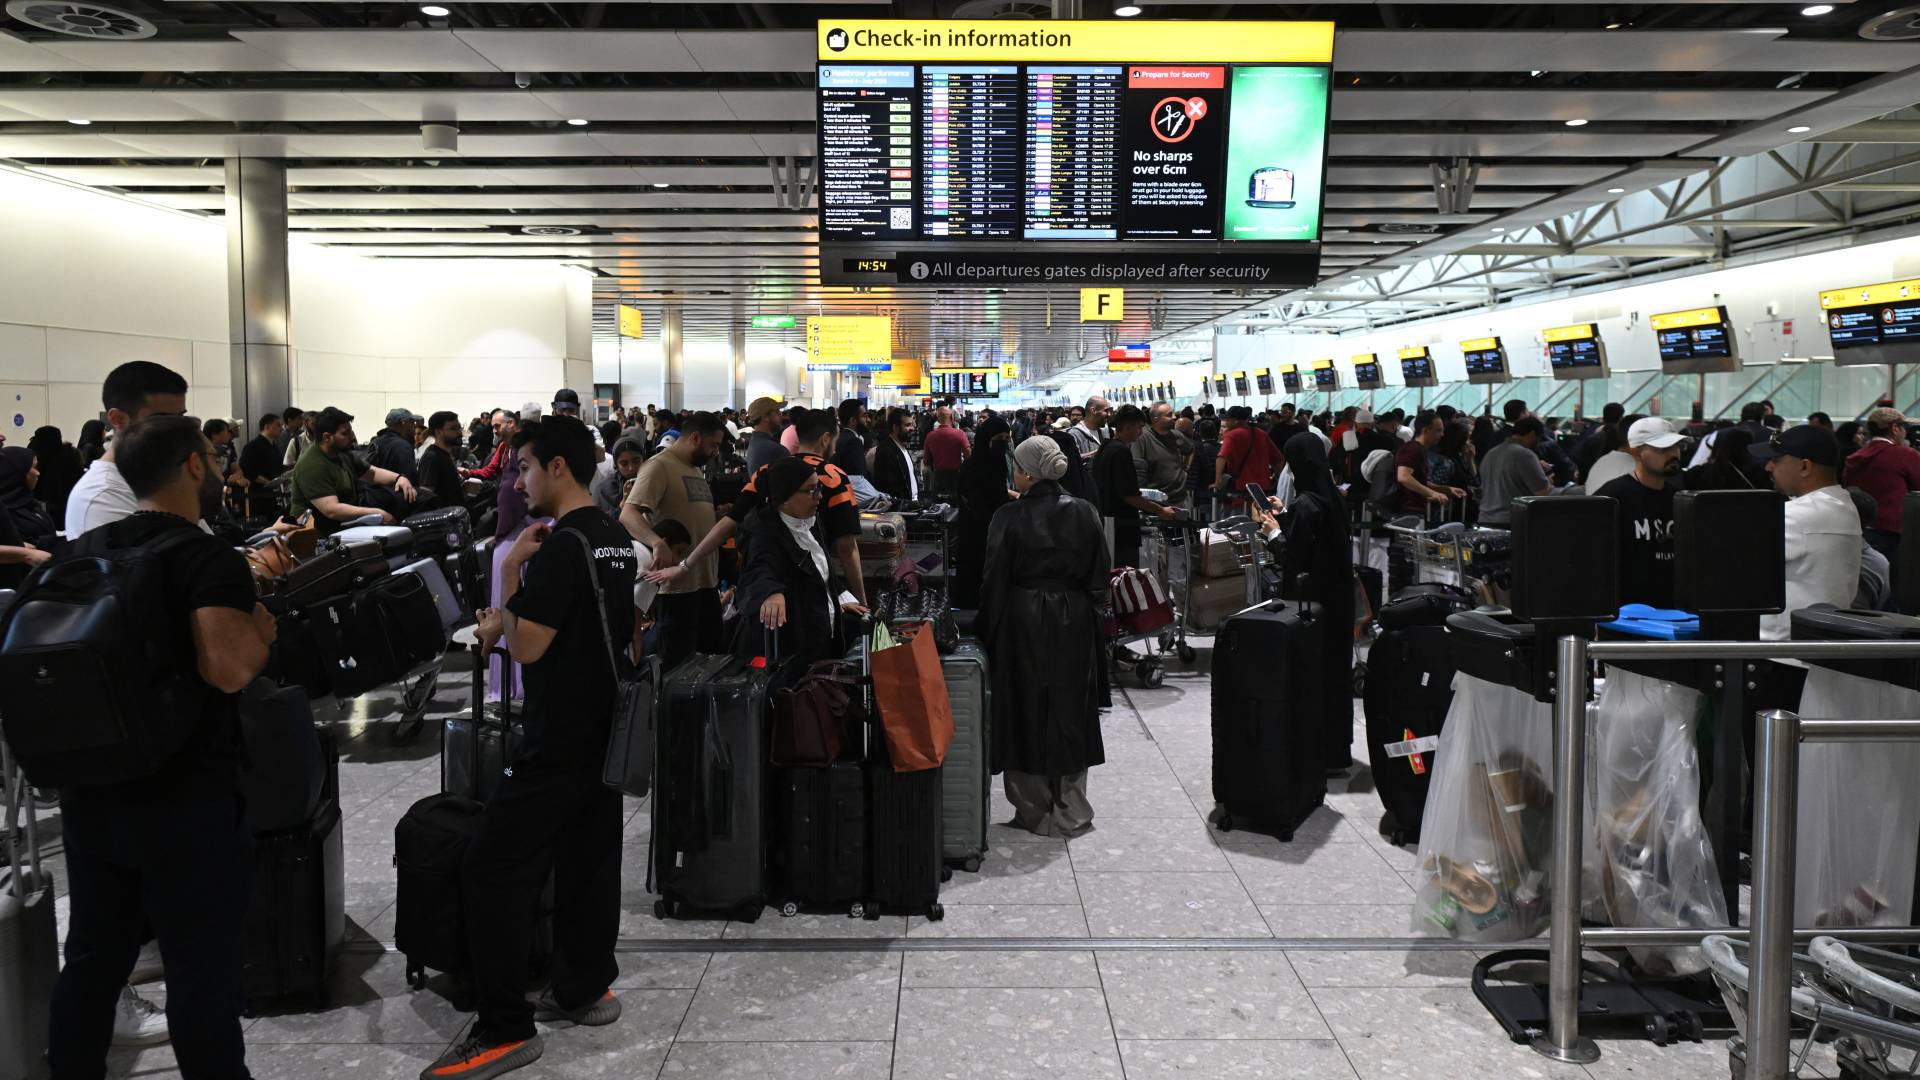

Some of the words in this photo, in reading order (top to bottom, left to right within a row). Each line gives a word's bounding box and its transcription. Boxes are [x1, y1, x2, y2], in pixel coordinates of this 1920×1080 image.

[854, 29, 942, 47] Check-in
[948, 29, 1072, 47] information
[1134, 151, 1150, 161] No
[1153, 151, 1192, 164] sharps
[1133, 166, 1161, 174] over
[1163, 164, 1186, 174] 6cm
[858, 260, 887, 271] 14:54
[933, 263, 952, 276] All
[956, 263, 1040, 280] departures
[1045, 264, 1086, 281] gates
[1090, 263, 1165, 282] displayed
[1169, 263, 1204, 278] after
[1209, 263, 1270, 280] security
[1098, 294, 1110, 315] F
